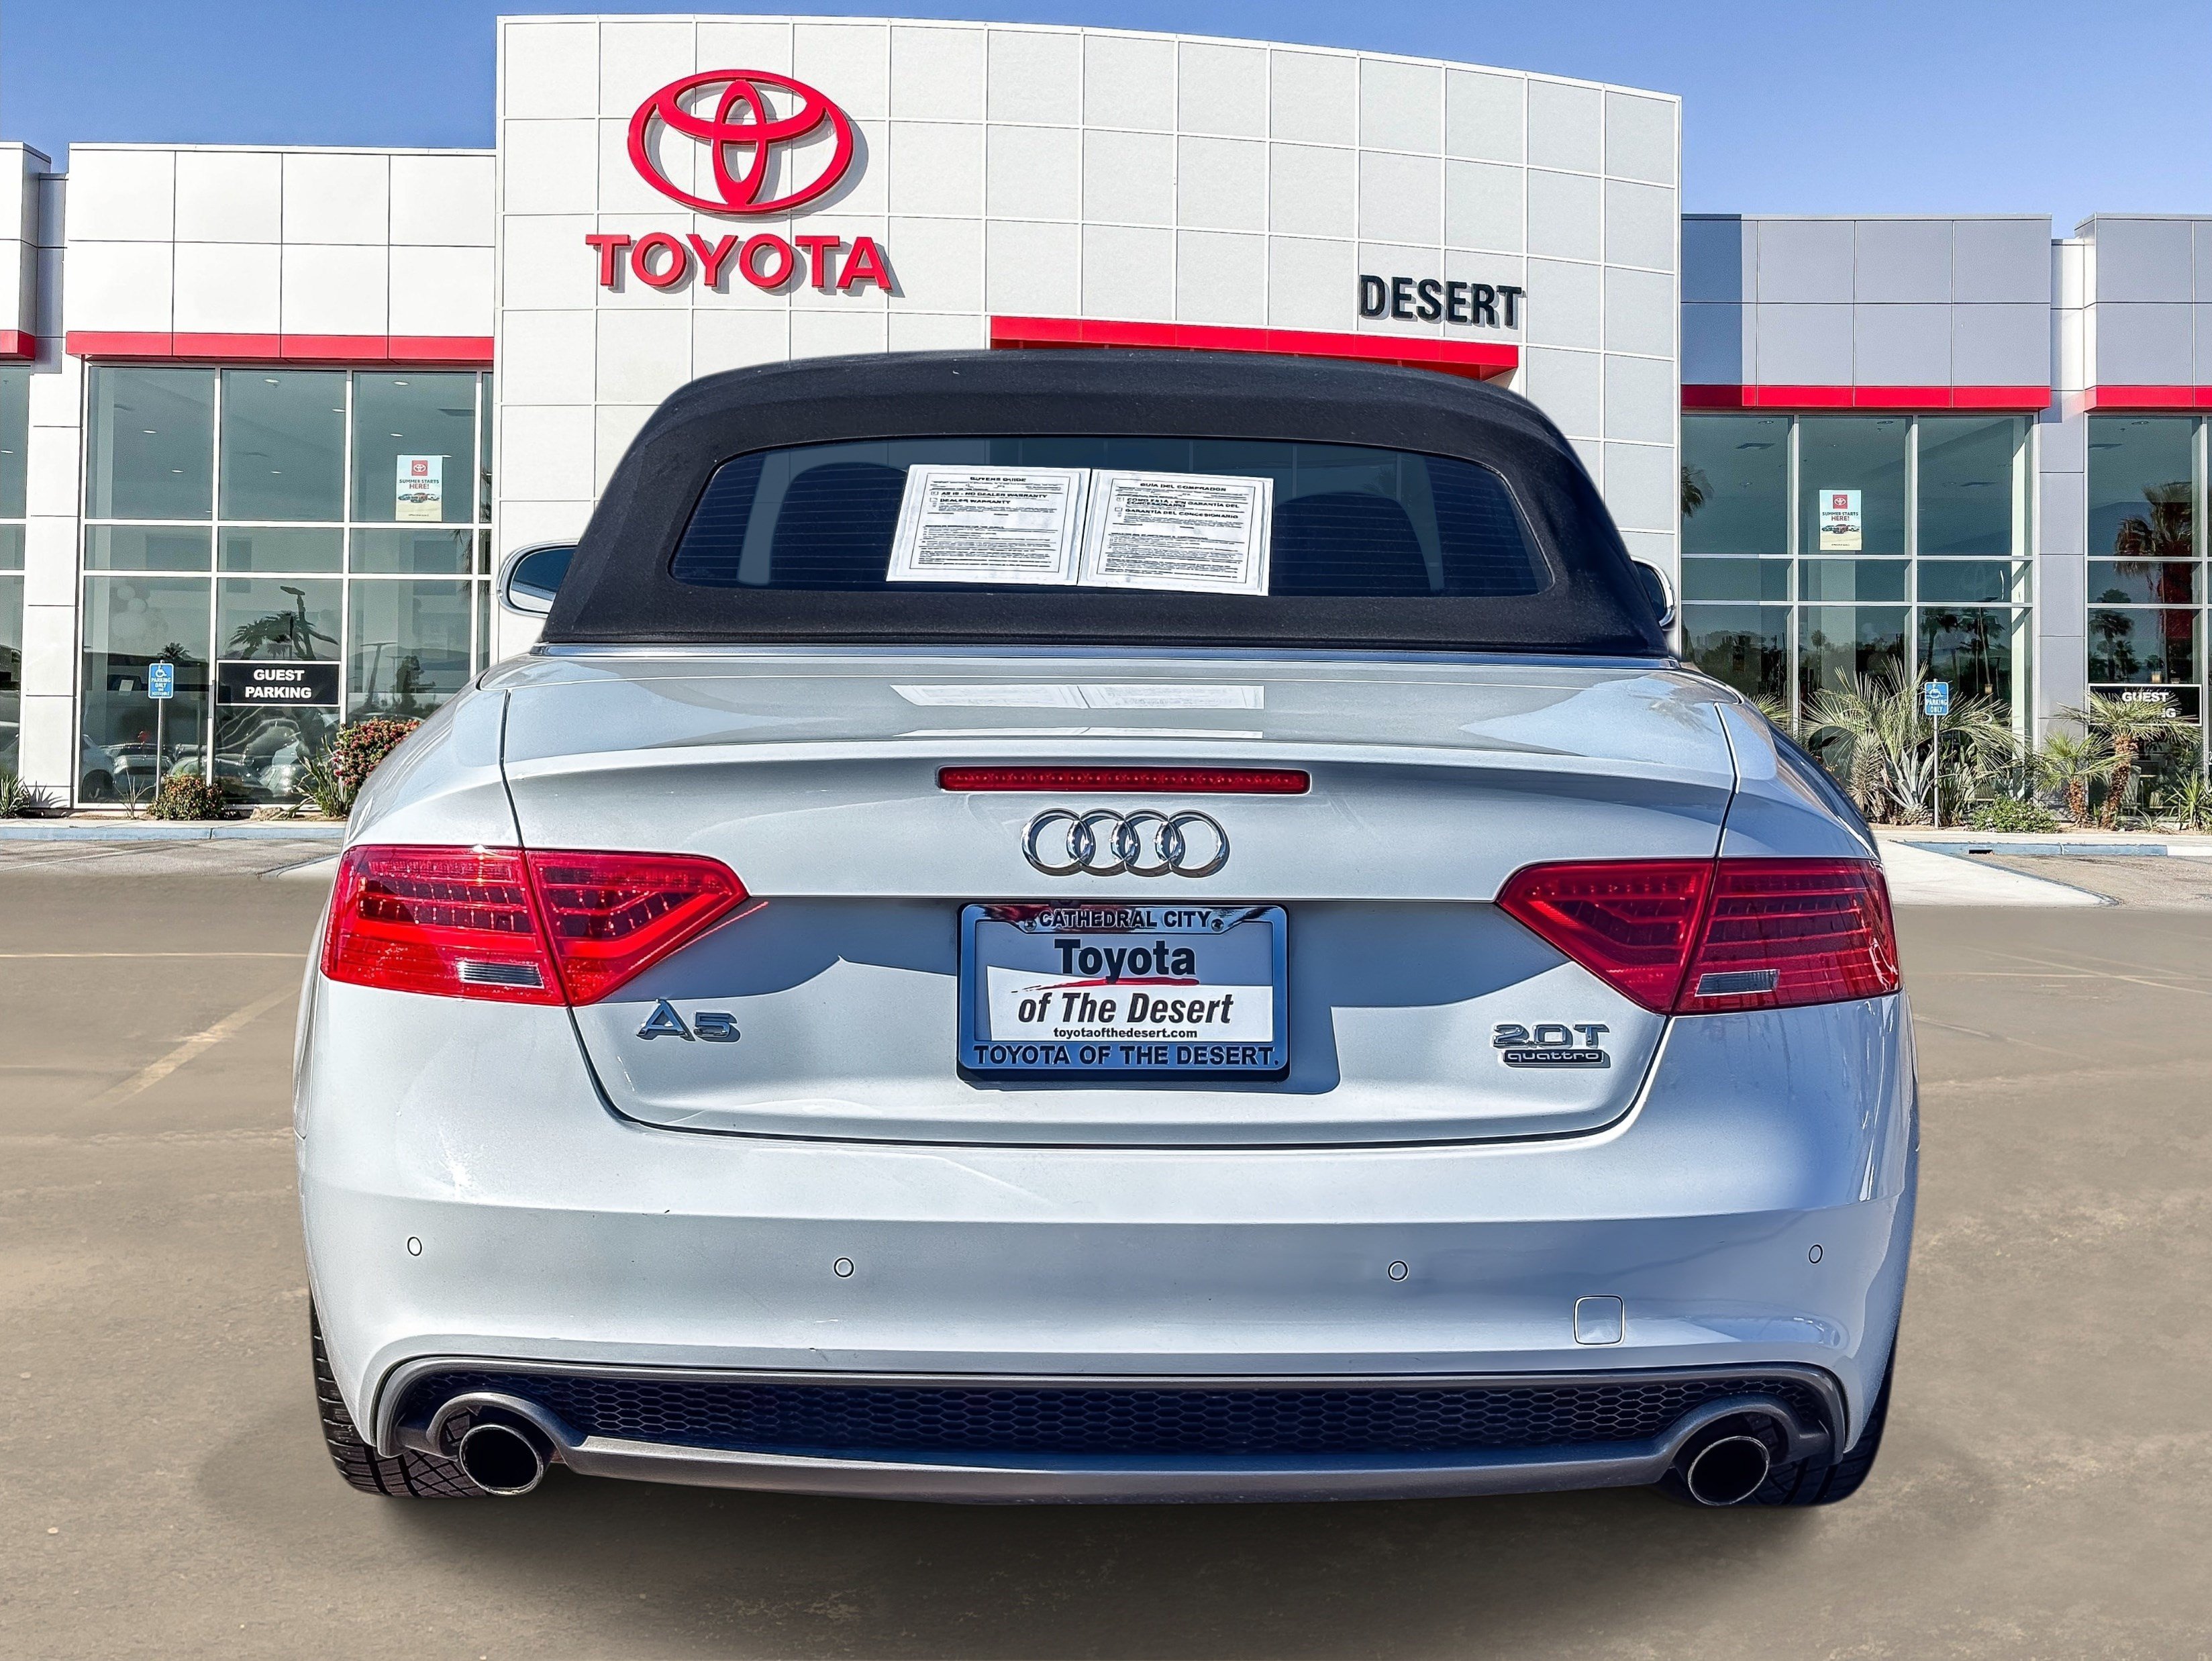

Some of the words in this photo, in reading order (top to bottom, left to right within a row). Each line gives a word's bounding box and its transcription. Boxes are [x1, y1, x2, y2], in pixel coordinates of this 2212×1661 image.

[585, 232, 893, 291] TOYOTA
[1359, 274, 1523, 327] DESERT
[253, 669, 305, 681] GUEST
[244, 686, 312, 699] PARKING
[2121, 692, 2169, 702] GUEST
[1039, 910, 1158, 929] CATHEDRAL
[1163, 910, 1210, 928] CITY
[1054, 938, 1197, 984] Toyota
[1018, 993, 1058, 1023] of
[1062, 993, 1115, 1023] The
[1127, 993, 1234, 1023] Desert
[636, 999, 741, 1042] A5
[1053, 1027, 1198, 1040] toyotaofthedesert.com
[973, 1045, 1070, 1065] TOYOTA
[1078, 1045, 1112, 1065] OF
[1119, 1045, 1169, 1065] THE
[1507, 1051, 1599, 1062] quattro
